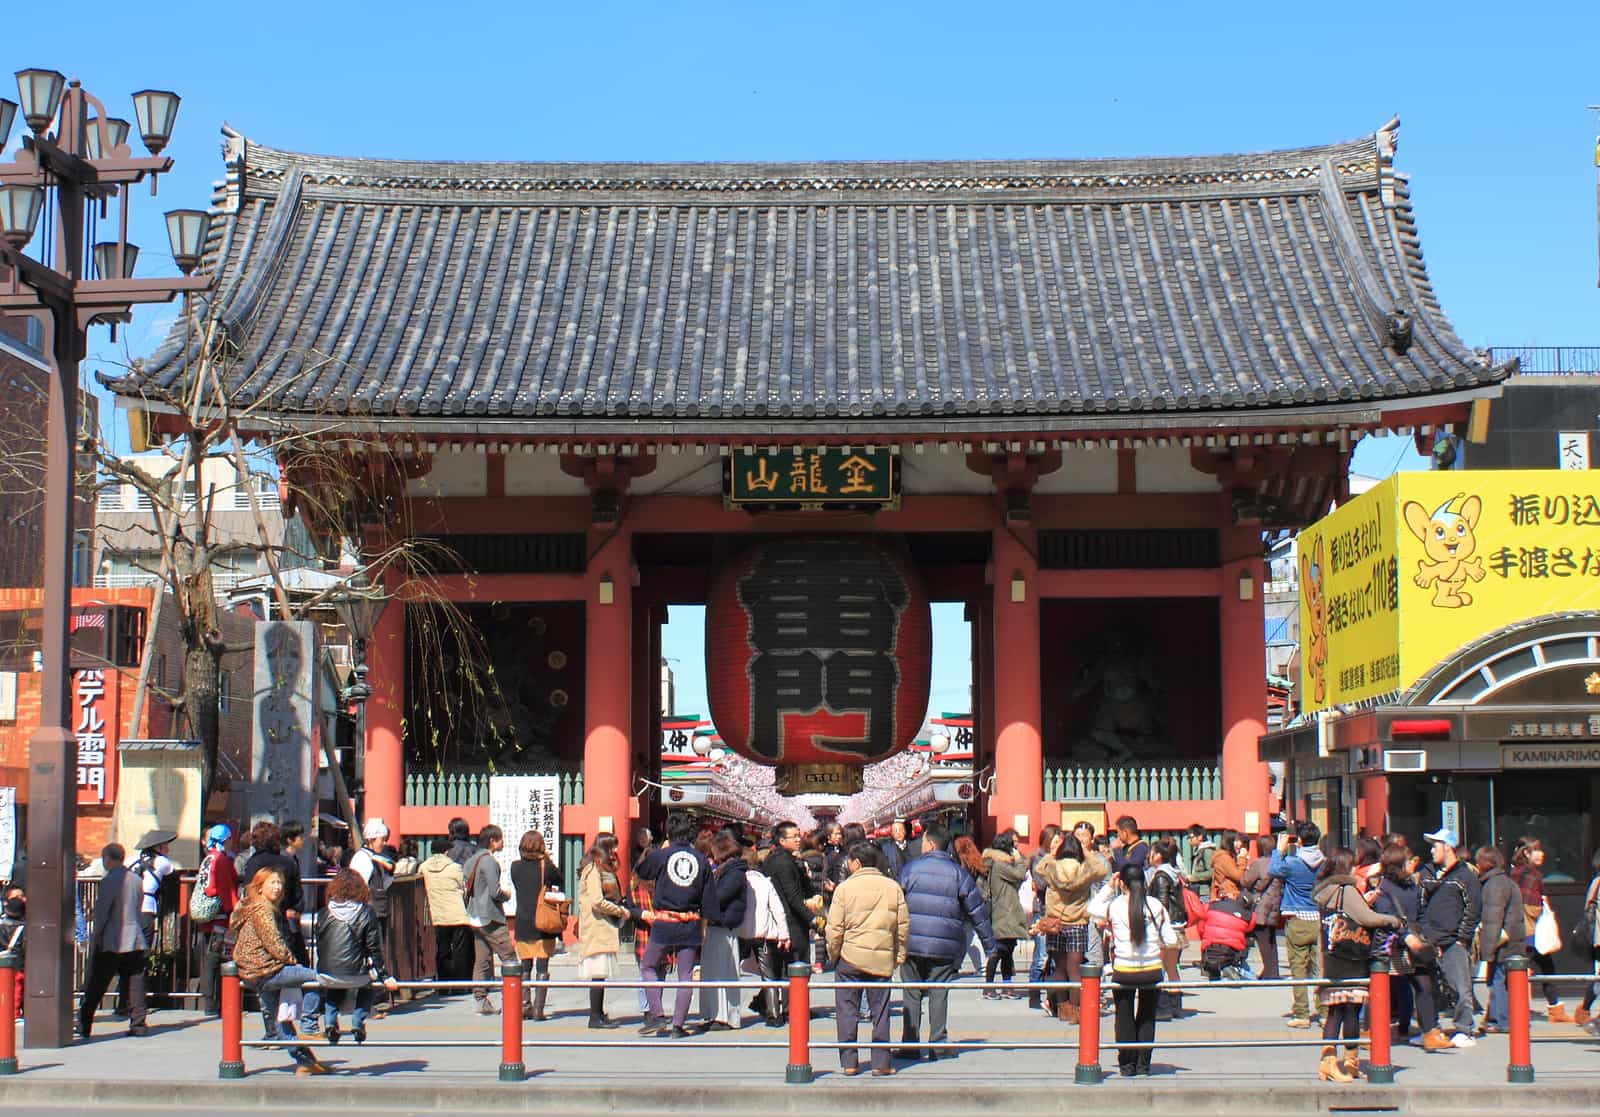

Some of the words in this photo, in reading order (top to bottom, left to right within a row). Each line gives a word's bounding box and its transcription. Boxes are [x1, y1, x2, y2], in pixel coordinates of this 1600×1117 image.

[747, 454, 877, 493] 金龍山
[1509, 494, 1600, 526] 振り込
[735, 540, 911, 760] 雷門
[1513, 750, 1600, 762] KAMINARIMO
[543, 789, 554, 855] 三社祭斎行
[1331, 918, 1371, 944] Barbie
